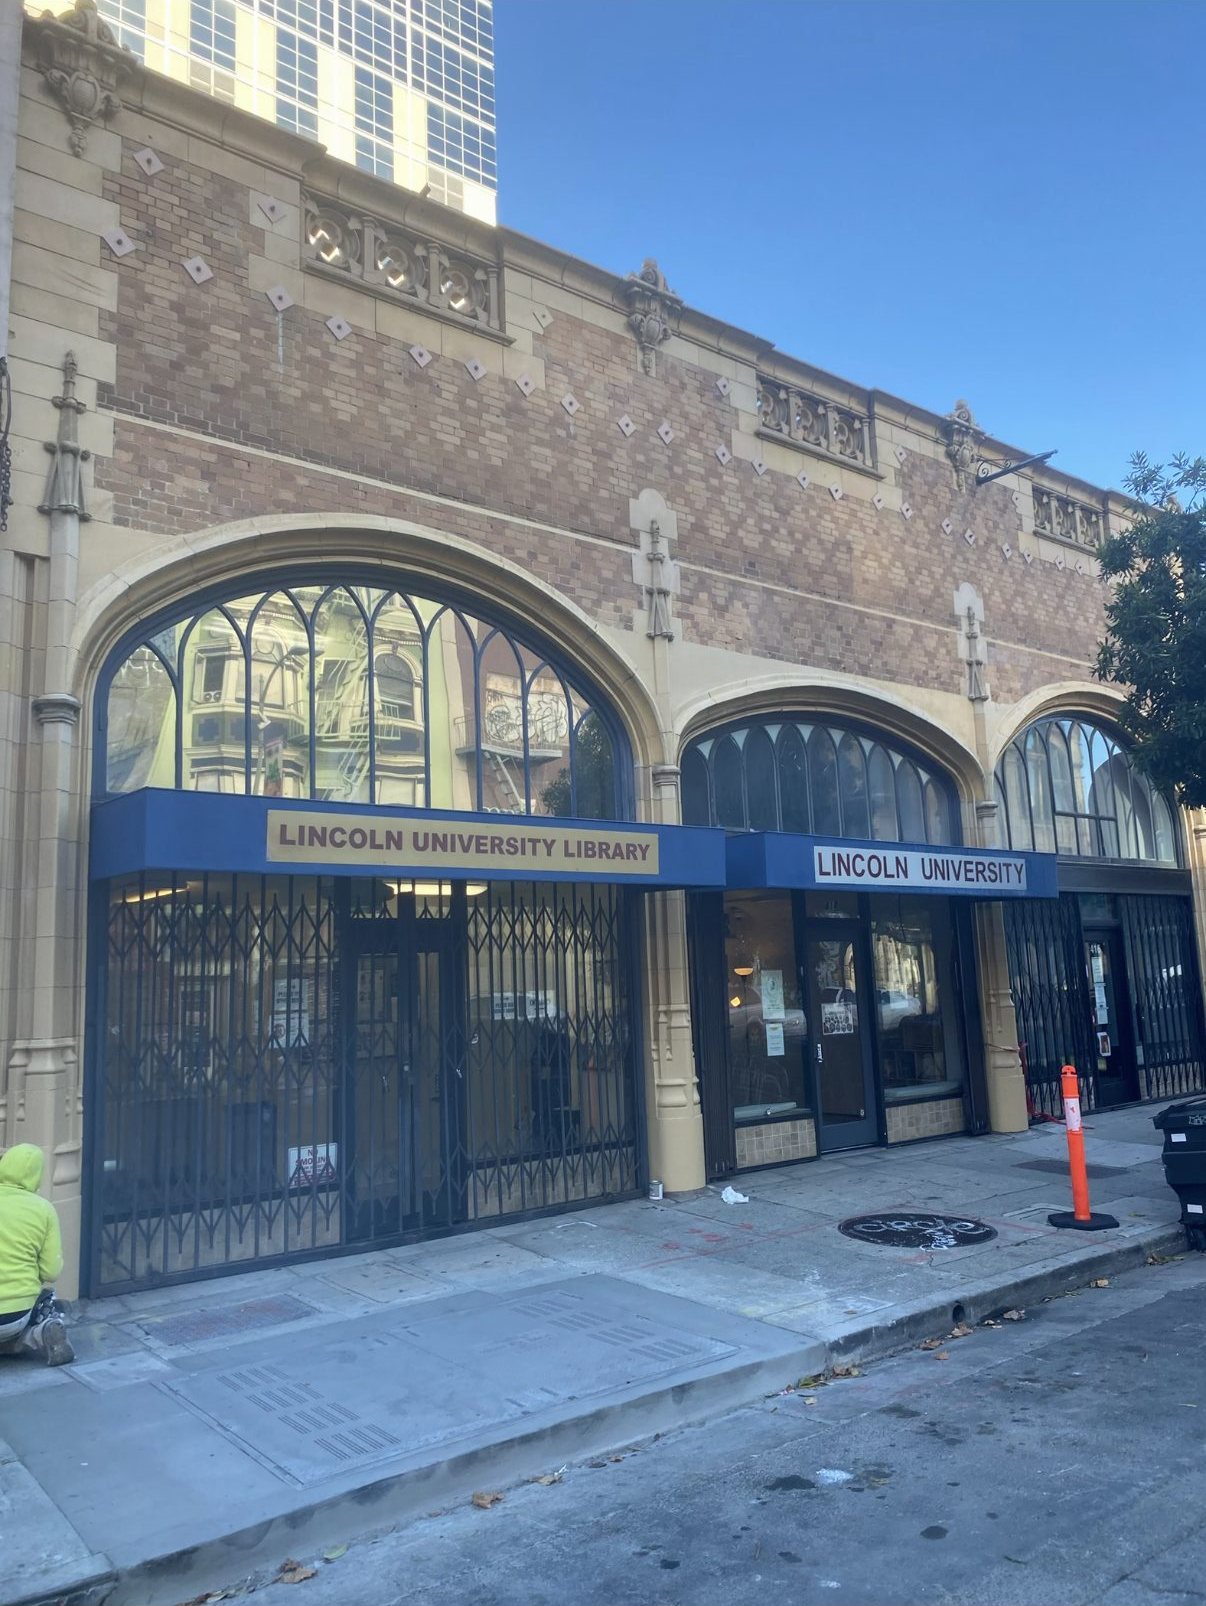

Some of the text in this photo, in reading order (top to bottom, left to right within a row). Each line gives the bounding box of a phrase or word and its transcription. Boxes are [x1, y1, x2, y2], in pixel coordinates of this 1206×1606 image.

[279, 823, 651, 861] LINCOLN UNIVERSITY LIBRARY
[818, 852, 1024, 884] LINCOLN UNIVERSITY
